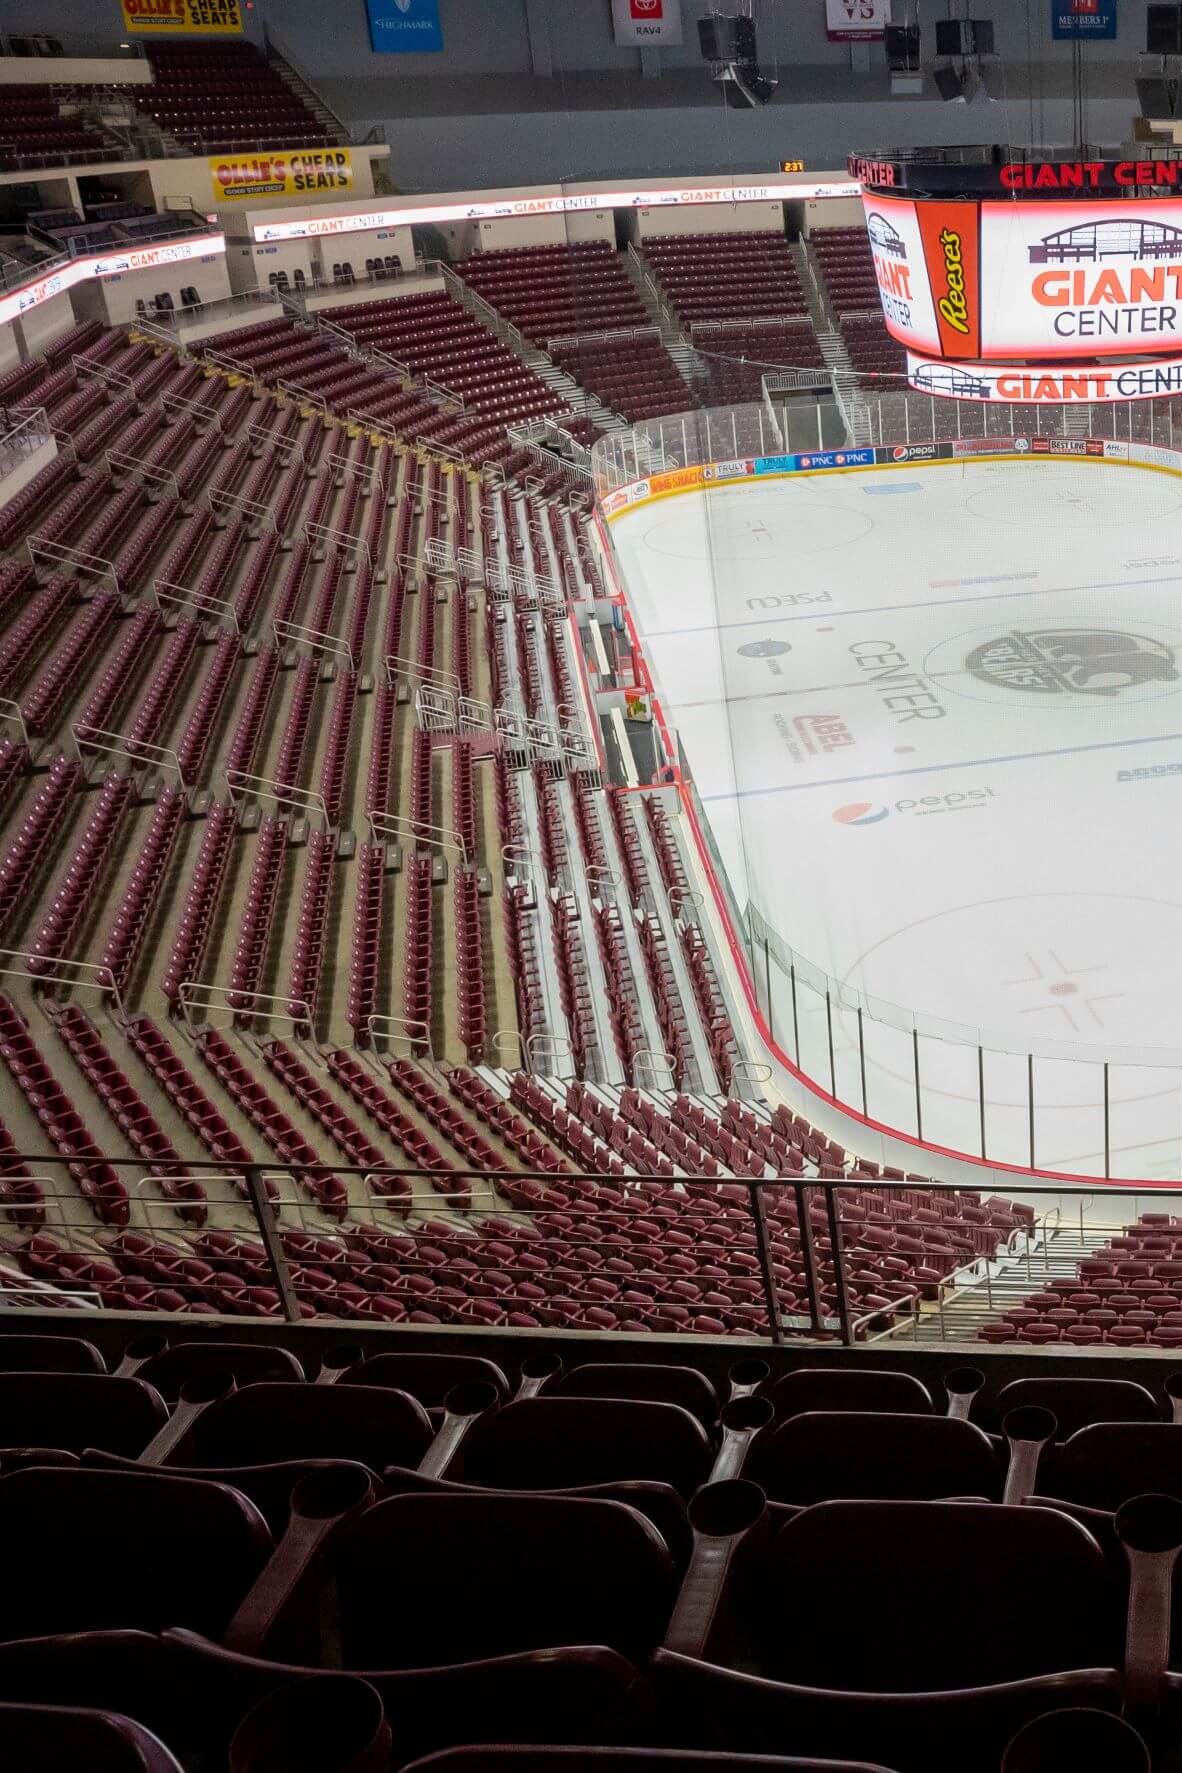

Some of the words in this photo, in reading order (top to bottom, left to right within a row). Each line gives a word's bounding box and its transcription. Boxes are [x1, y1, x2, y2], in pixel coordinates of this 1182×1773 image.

[125, 0, 186, 16] OLLIES
[191, 12, 240, 26] SEATS
[1059, 15, 1101, 25] MEBERS
[635, 26, 662, 36] RAV4
[217, 156, 287, 186] OLLIE'S
[290, 152, 347, 174] CHEAP
[294, 172, 349, 191] SEATS
[1000, 162, 1104, 191] GIANT
[680, 191, 721, 202] GIANT
[722, 188, 768, 201] CENTER
[514, 201, 554, 213] GIANT
[555, 197, 597, 211] CENTER
[307, 220, 344, 234] GIANT
[130, 250, 161, 268] GIANT
[160, 245, 192, 262] CENTER
[937, 228, 970, 335] Reese's
[1053, 306, 1178, 337] CENTER
[996, 373, 1111, 400] GIANT
[845, 453, 869, 464] PNC
[909, 445, 936, 457] pepsi
[716, 463, 744, 474] TRULY
[762, 456, 787, 466] TRULY
[811, 456, 833, 466] PNC
[745, 590, 833, 610] PSECU
[848, 640, 947, 724] CENTER
[895, 785, 1000, 813] pepsi
